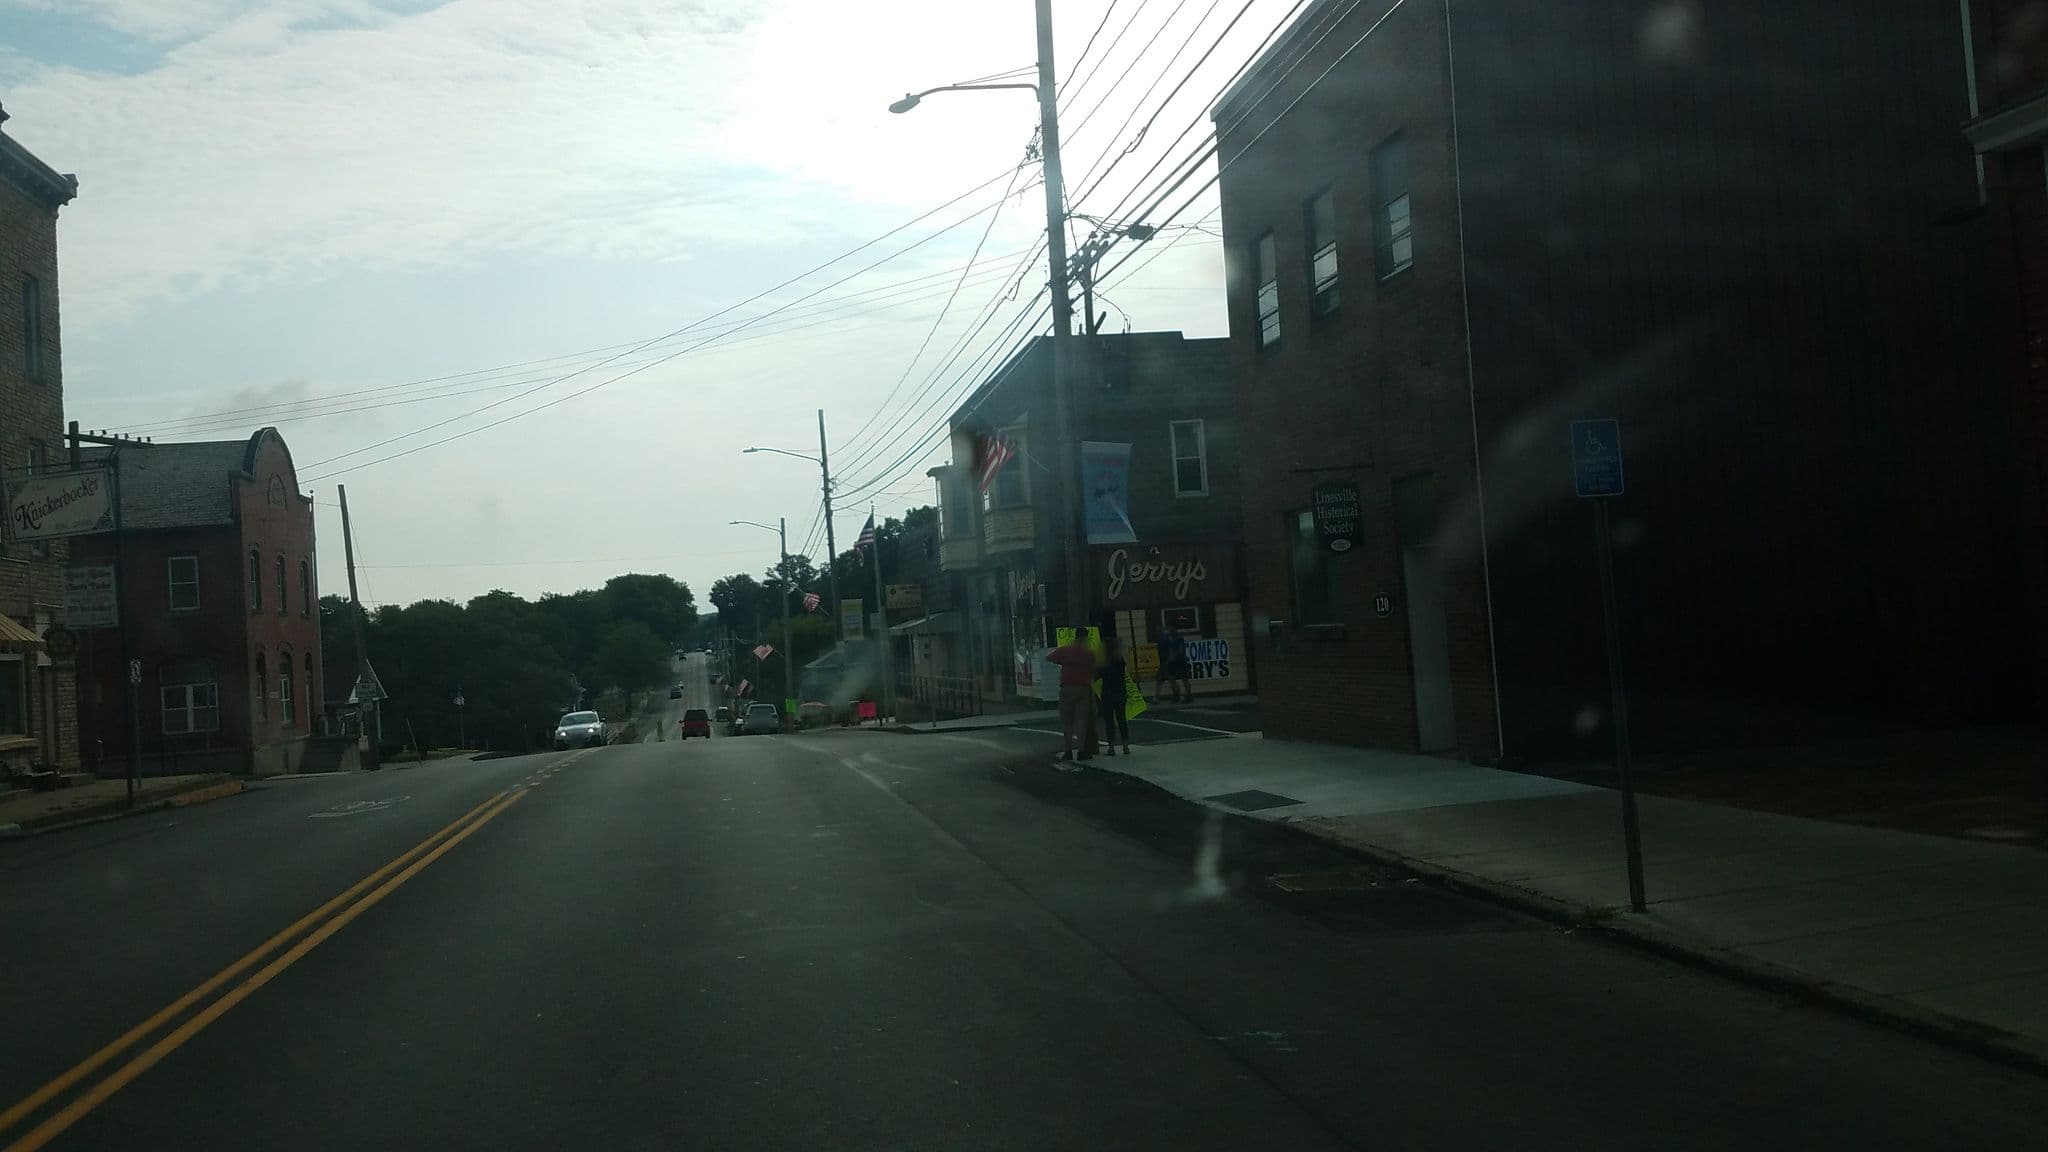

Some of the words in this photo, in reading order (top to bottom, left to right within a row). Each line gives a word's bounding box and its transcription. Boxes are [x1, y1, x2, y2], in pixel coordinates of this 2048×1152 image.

[15, 477, 98, 530] Knickerbocker
[1315, 487, 1358, 505] Linesville
[1317, 503, 1360, 519] Historical
[1323, 520, 1354, 536] Society
[1375, 596, 1390, 612] 120
[1183, 641, 1211, 661] COME
[1214, 640, 1228, 659] TO
[1186, 660, 1230, 679] RY'S
